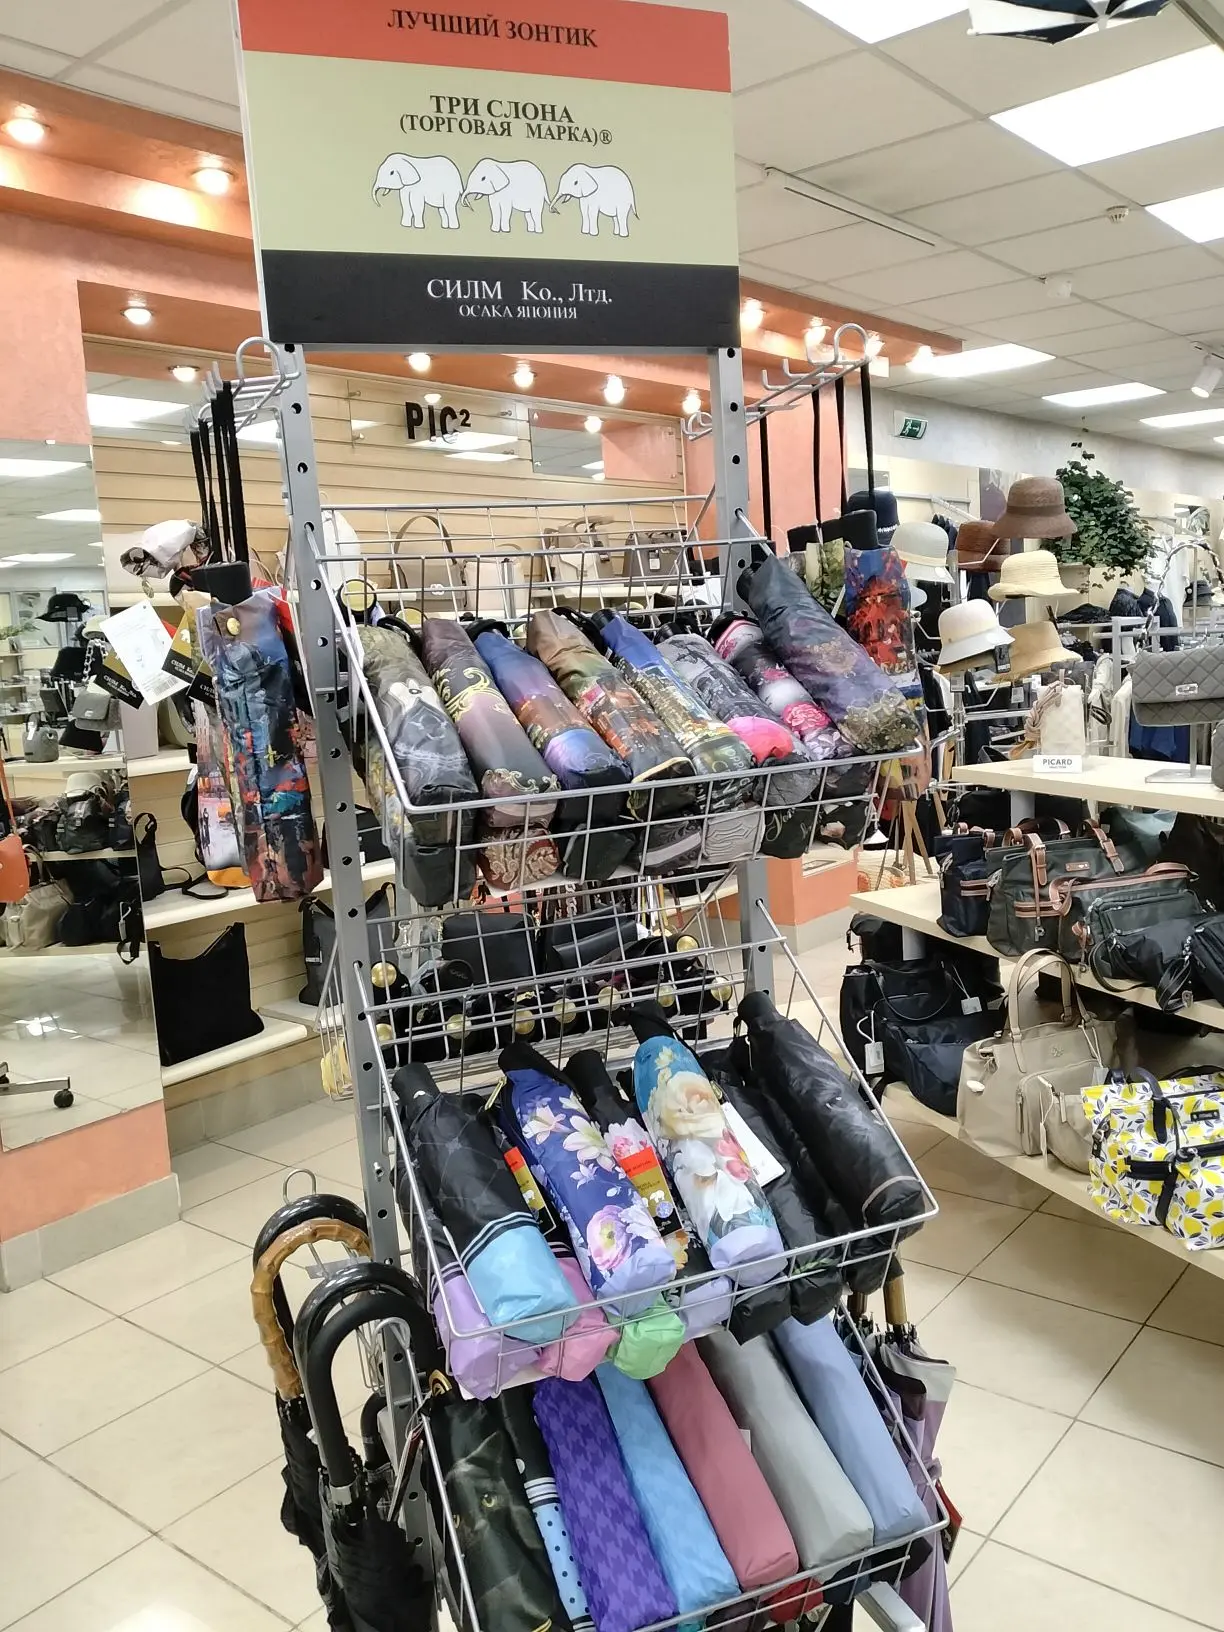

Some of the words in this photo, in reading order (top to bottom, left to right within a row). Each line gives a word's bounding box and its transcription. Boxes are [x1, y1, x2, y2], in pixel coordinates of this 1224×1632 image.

[387, 9, 500, 37] ЛУЧШИЙ
[505, 20, 598, 47] ЗОНТИК
[430, 95, 480, 116] ТРИ
[486, 99, 575, 123] СЛОНА
[400, 114, 512, 137] (ТОРГОВАЯ
[427, 279, 502, 300] СИЛМ
[521, 281, 563, 304] Ко.,
[568, 283, 613, 304] Лтд.
[459, 304, 513, 318] ОСАКА
[517, 306, 577, 319] ЯПОНИЯ
[1042, 758, 1073, 766] PICARD
